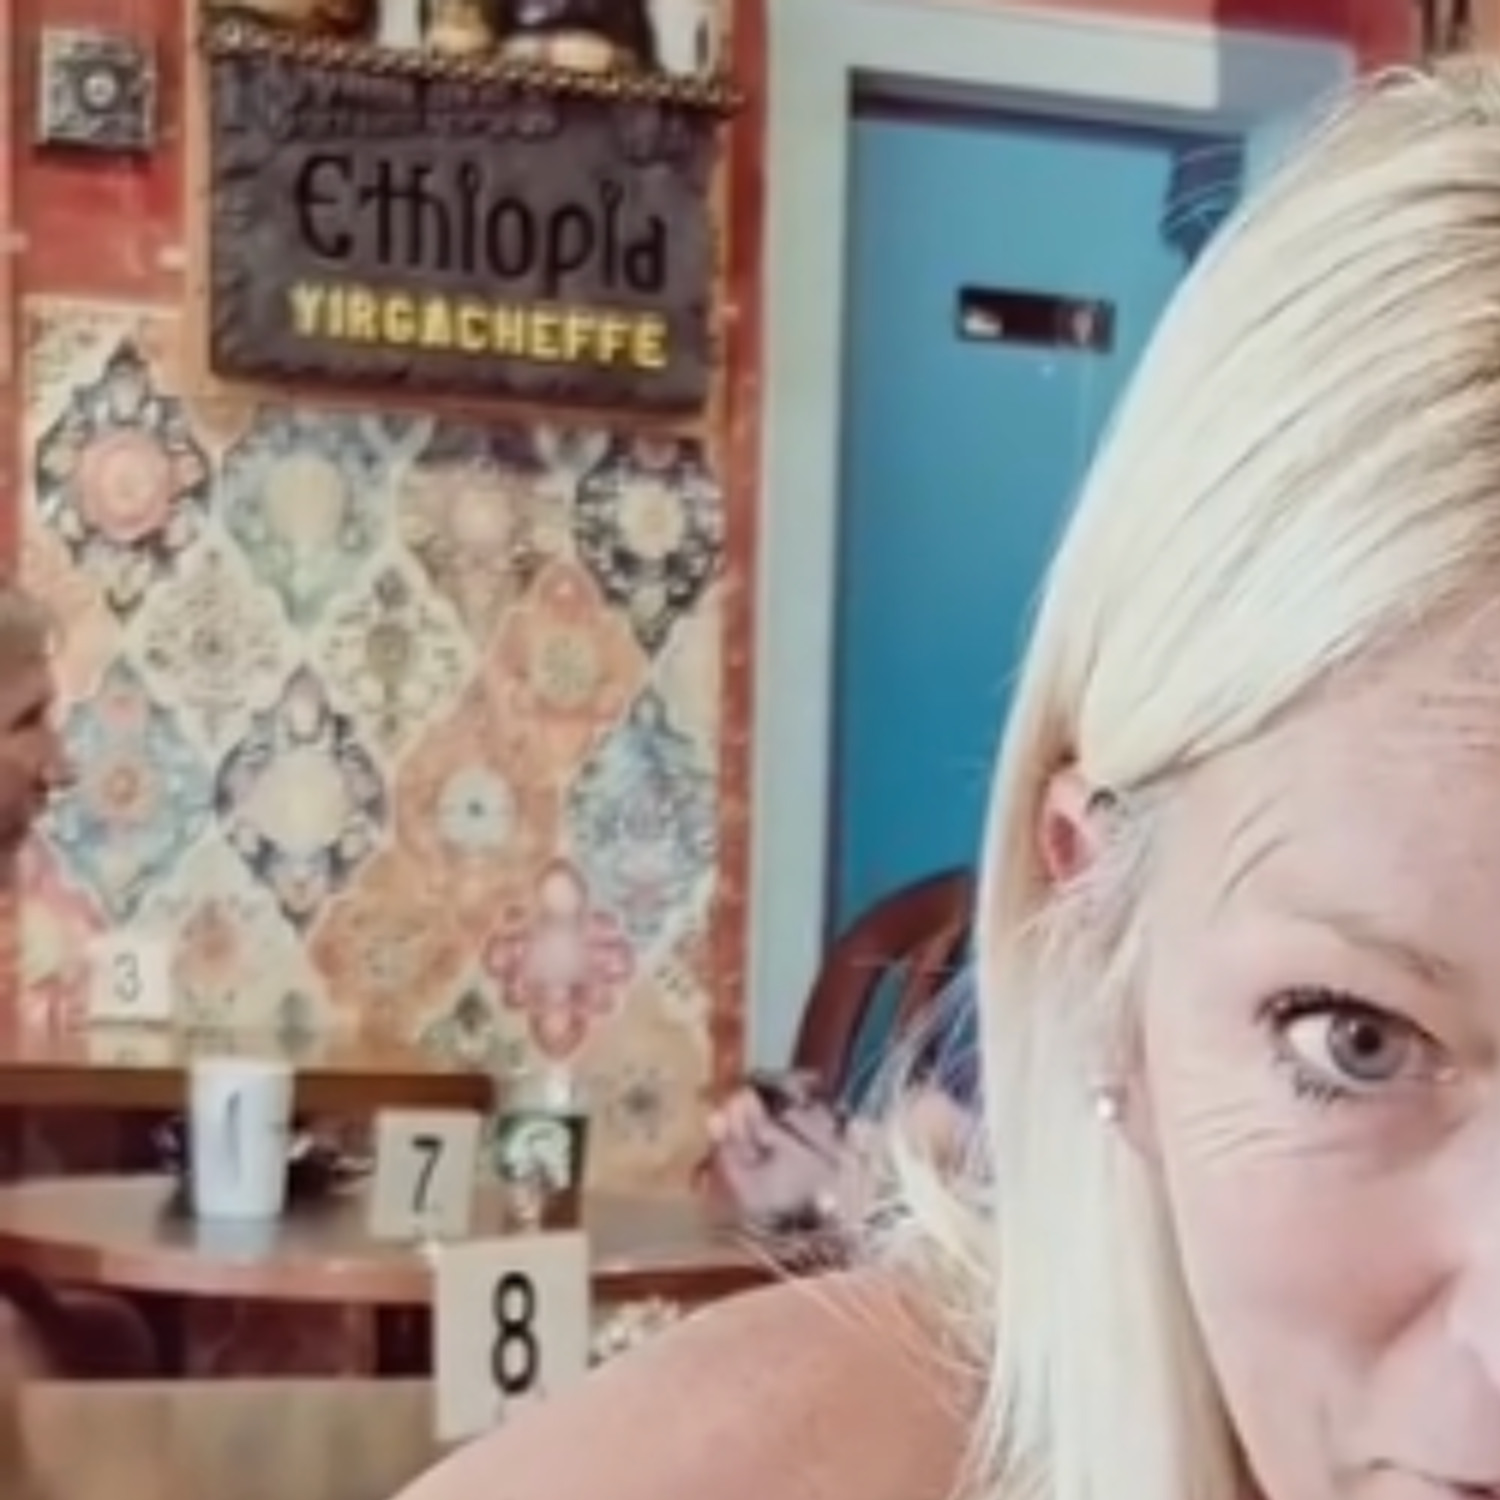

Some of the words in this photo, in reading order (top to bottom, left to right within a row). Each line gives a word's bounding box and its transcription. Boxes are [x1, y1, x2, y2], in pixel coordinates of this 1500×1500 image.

[297, 152, 667, 296] Ethiopia
[292, 284, 670, 368] YIRGACHEFFE
[112, 950, 143, 1002] 3
[410, 1135, 443, 1213] 7
[490, 1271, 540, 1395] 8
